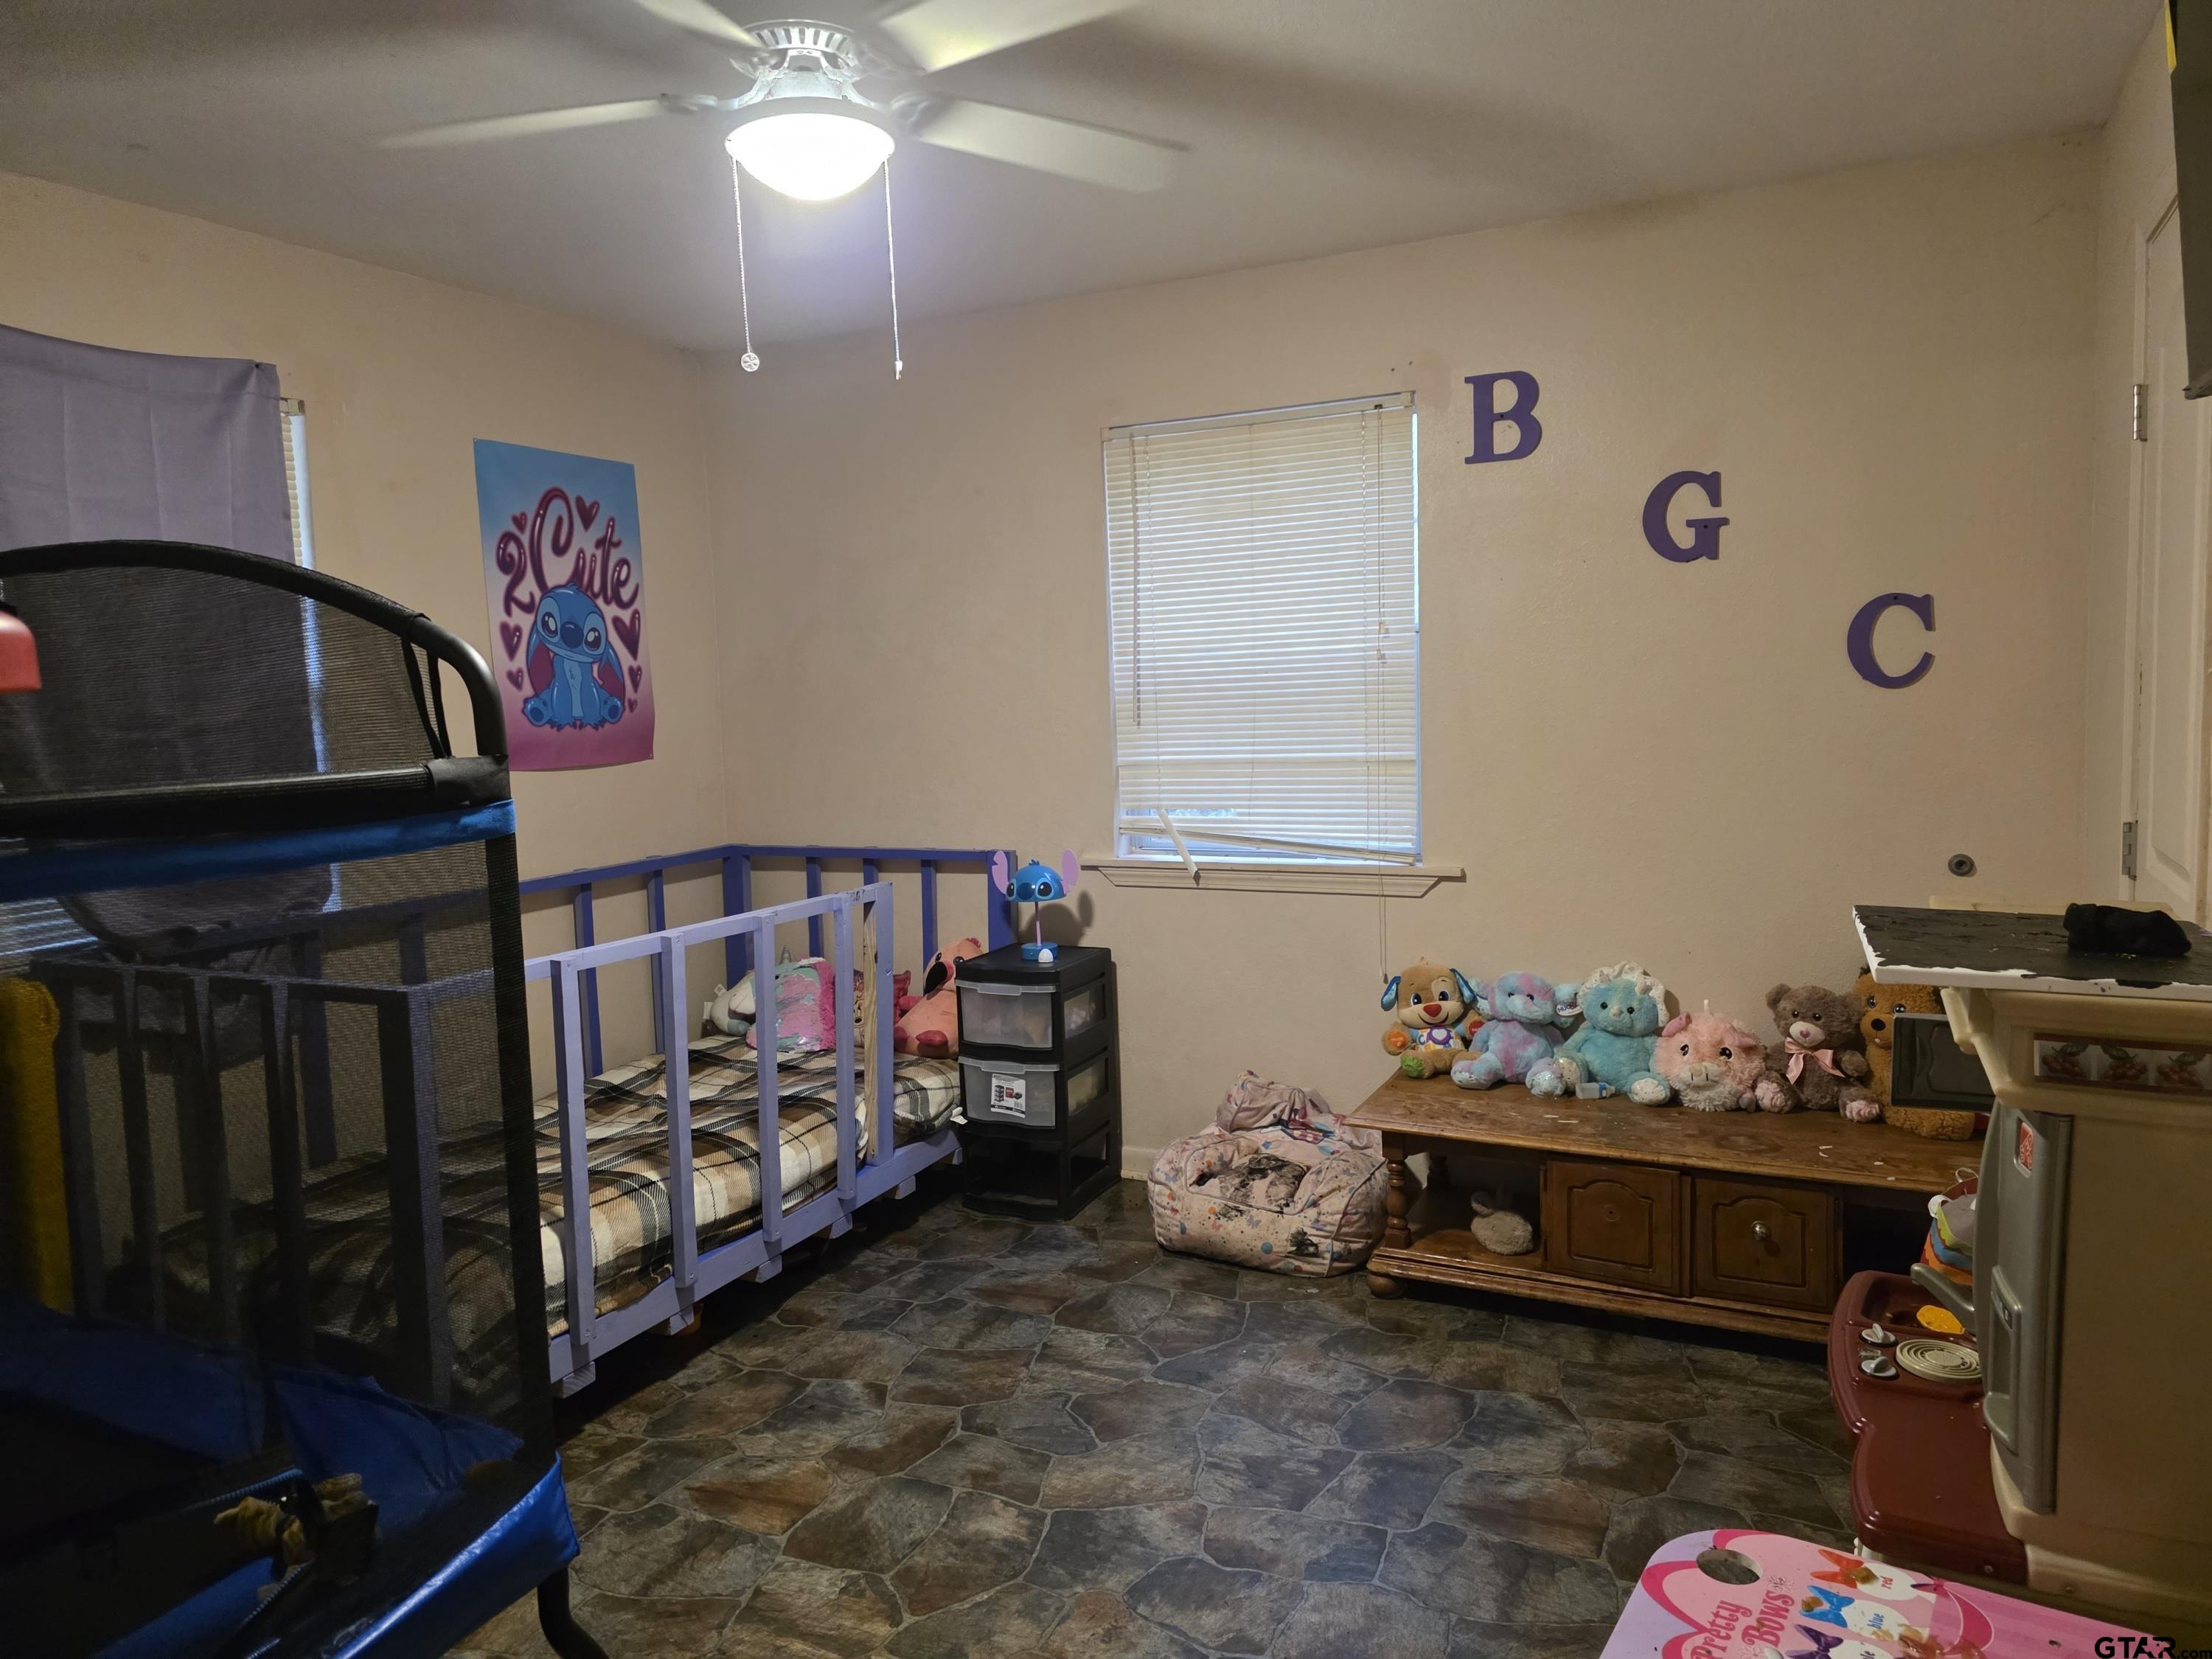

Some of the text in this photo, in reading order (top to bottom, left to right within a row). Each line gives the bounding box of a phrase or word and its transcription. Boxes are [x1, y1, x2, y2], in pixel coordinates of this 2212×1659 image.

[1464, 371, 1543, 465] B
[496, 486, 640, 618] 2 Cute
[1642, 470, 1730, 563] G
[1847, 593, 1935, 689] C
[1867, 1613, 1885, 1630] blue
[1879, 1576, 1893, 1590] red
